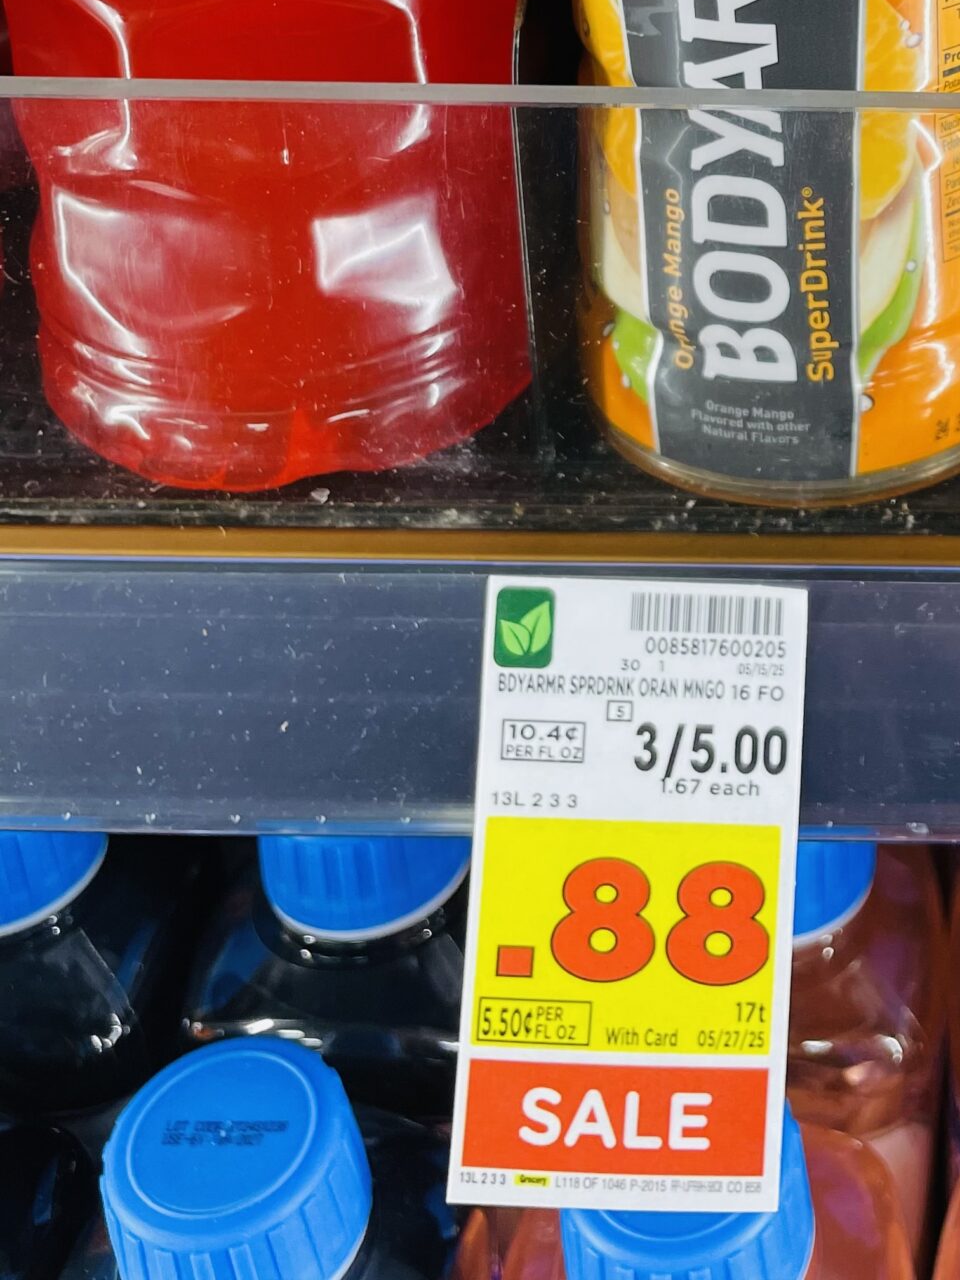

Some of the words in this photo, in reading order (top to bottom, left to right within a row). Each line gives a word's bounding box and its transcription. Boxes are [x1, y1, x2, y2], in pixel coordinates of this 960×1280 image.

[663, 187, 686, 277] Mango
[691, 408, 746, 429] Flavored
[706, 399, 749, 418] Orange
[752, 406, 795, 420] Mango
[702, 424, 748, 442] Natural
[645, 636, 787, 658] 0085817600205
[621, 659, 640, 672] 30
[498, 673, 566, 694] BDYARMR
[569, 675, 635, 696] SPRDRNK
[639, 677, 679, 698] ORAN
[682, 679, 726, 700] MNGO
[731, 685, 751, 701] 16
[758, 686, 785, 702] FO
[508, 723, 578, 742] 10.4¢
[506, 745, 533, 758] PER
[537, 746, 553, 758] FL
[560, 747, 583, 760] OZ
[633, 721, 788, 779] 3/5.00
[661, 778, 702, 796] 1.67
[709, 779, 760, 797] each
[491, 791, 529, 807] 13L
[532, 793, 543, 808] 2
[550, 794, 561, 809] 3
[568, 794, 578, 809] 3
[495, 856, 770, 987] .88
[482, 1007, 533, 1038] 5.50¢
[536, 1006, 564, 1021] PER
[735, 1002, 766, 1023] 17t
[535, 1024, 552, 1039] FL
[556, 1025, 577, 1040] OZ
[605, 1028, 640, 1046] With
[644, 1028, 679, 1047] Card
[697, 1030, 765, 1049] 05/27/25
[518, 1086, 713, 1151] SALE
